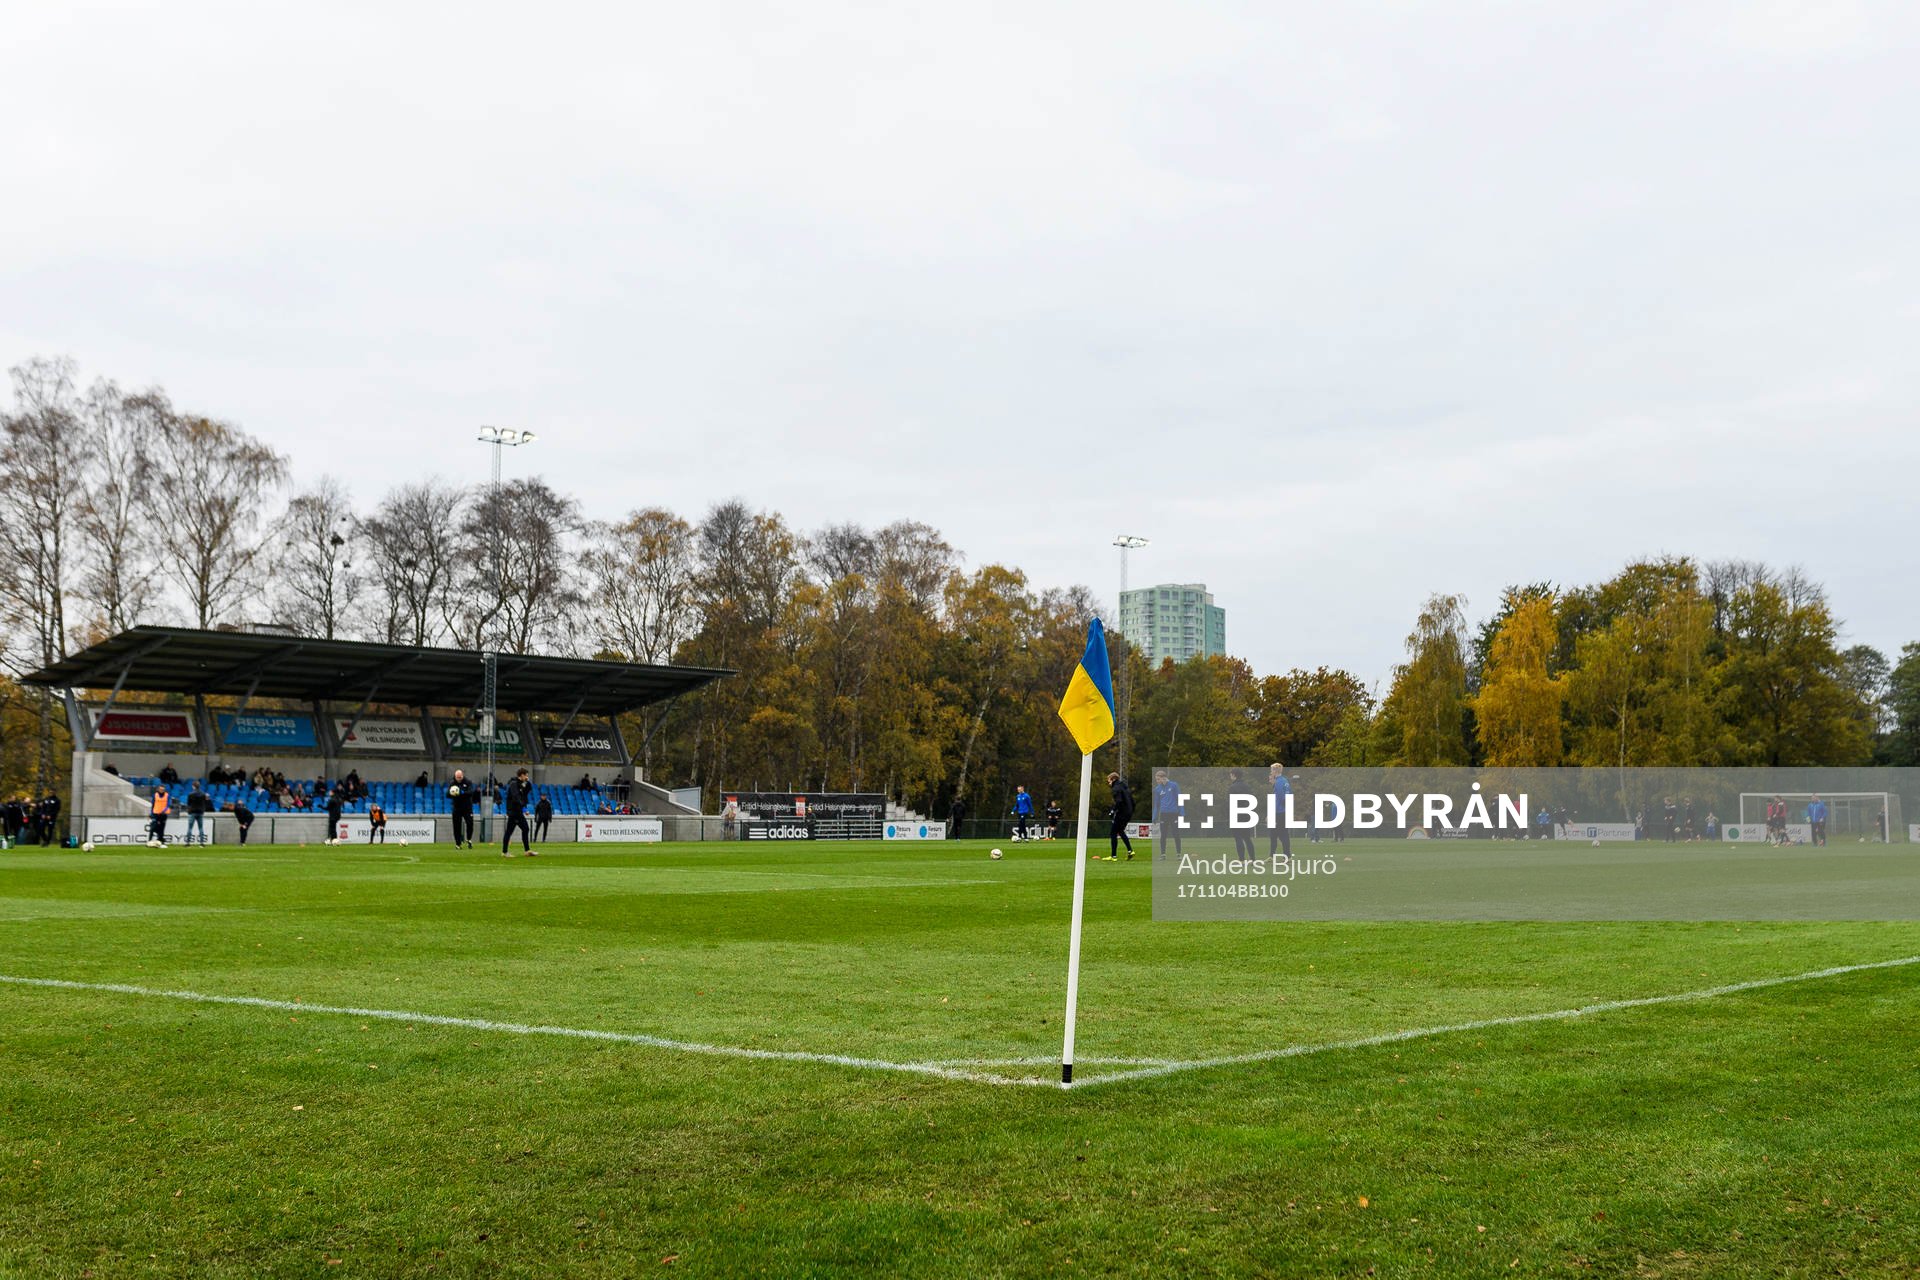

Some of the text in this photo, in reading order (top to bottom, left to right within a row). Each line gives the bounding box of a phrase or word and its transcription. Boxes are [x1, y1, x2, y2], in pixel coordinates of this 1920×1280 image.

[235, 717, 297, 728] RESURS
[238, 727, 272, 735] BANK
[365, 736, 417, 744] HELSINGBORG
[566, 736, 612, 750] adidas
[768, 825, 809, 839] adidas
